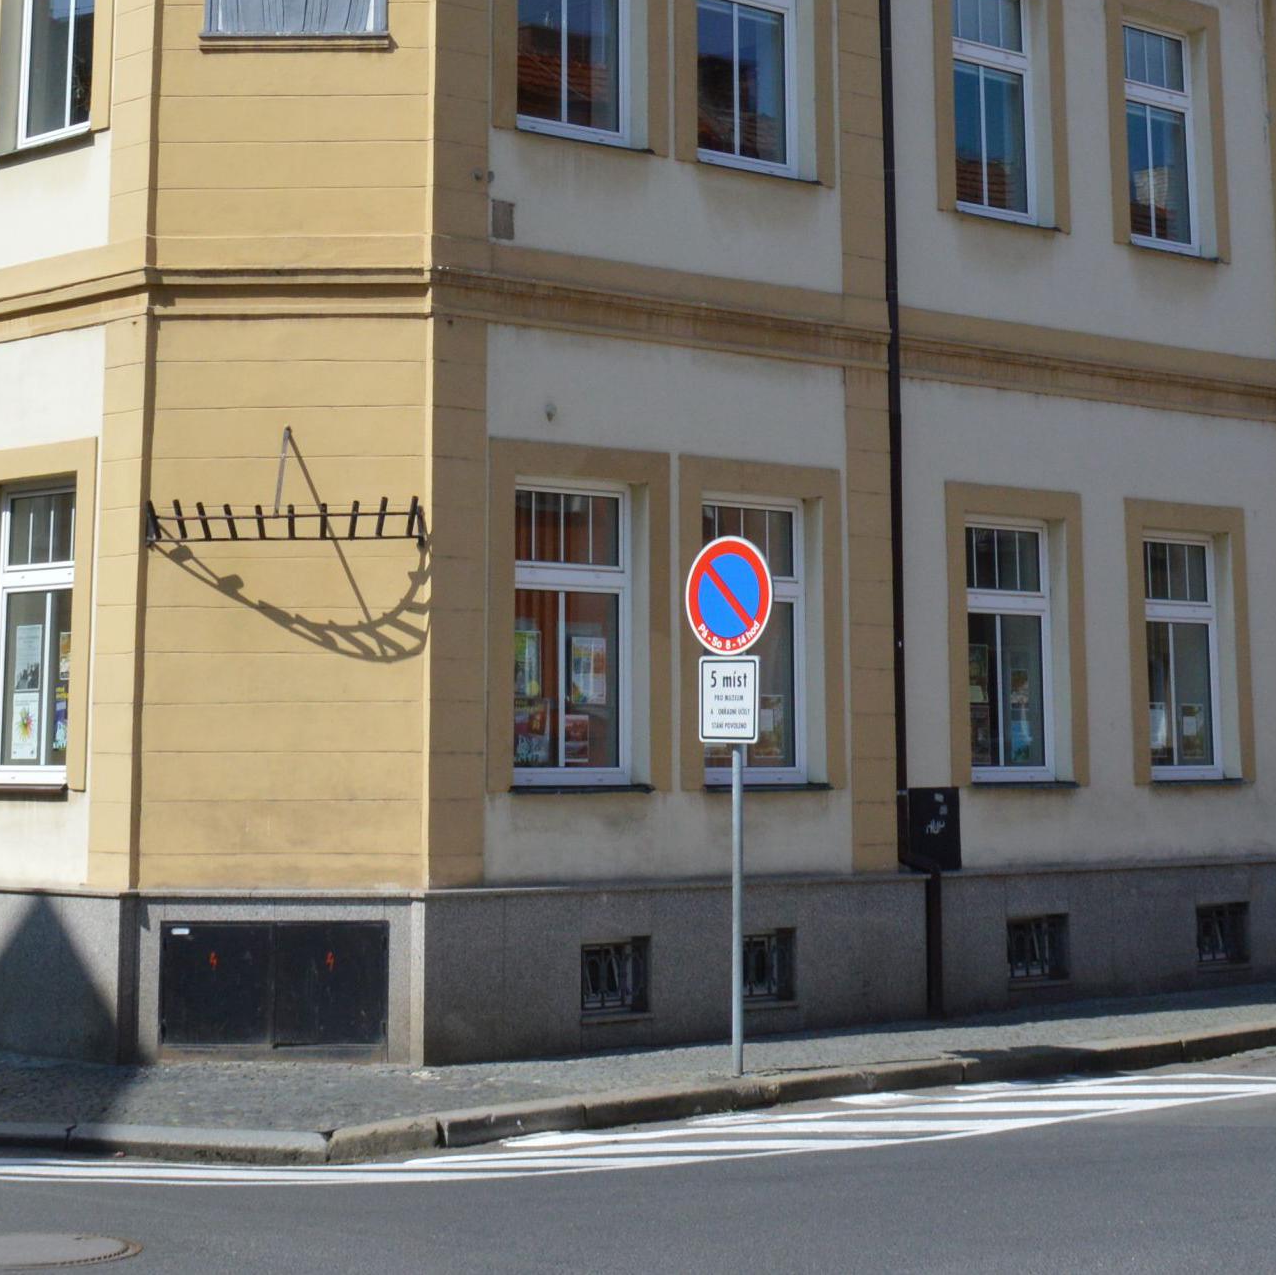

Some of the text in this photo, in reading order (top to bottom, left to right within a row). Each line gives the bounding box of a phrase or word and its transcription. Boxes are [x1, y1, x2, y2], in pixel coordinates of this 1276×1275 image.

[711, 636, 723, 649] So
[737, 634, 747, 647] 14
[745, 620, 760, 640] hod
[710, 670, 747, 688] 5 míst
